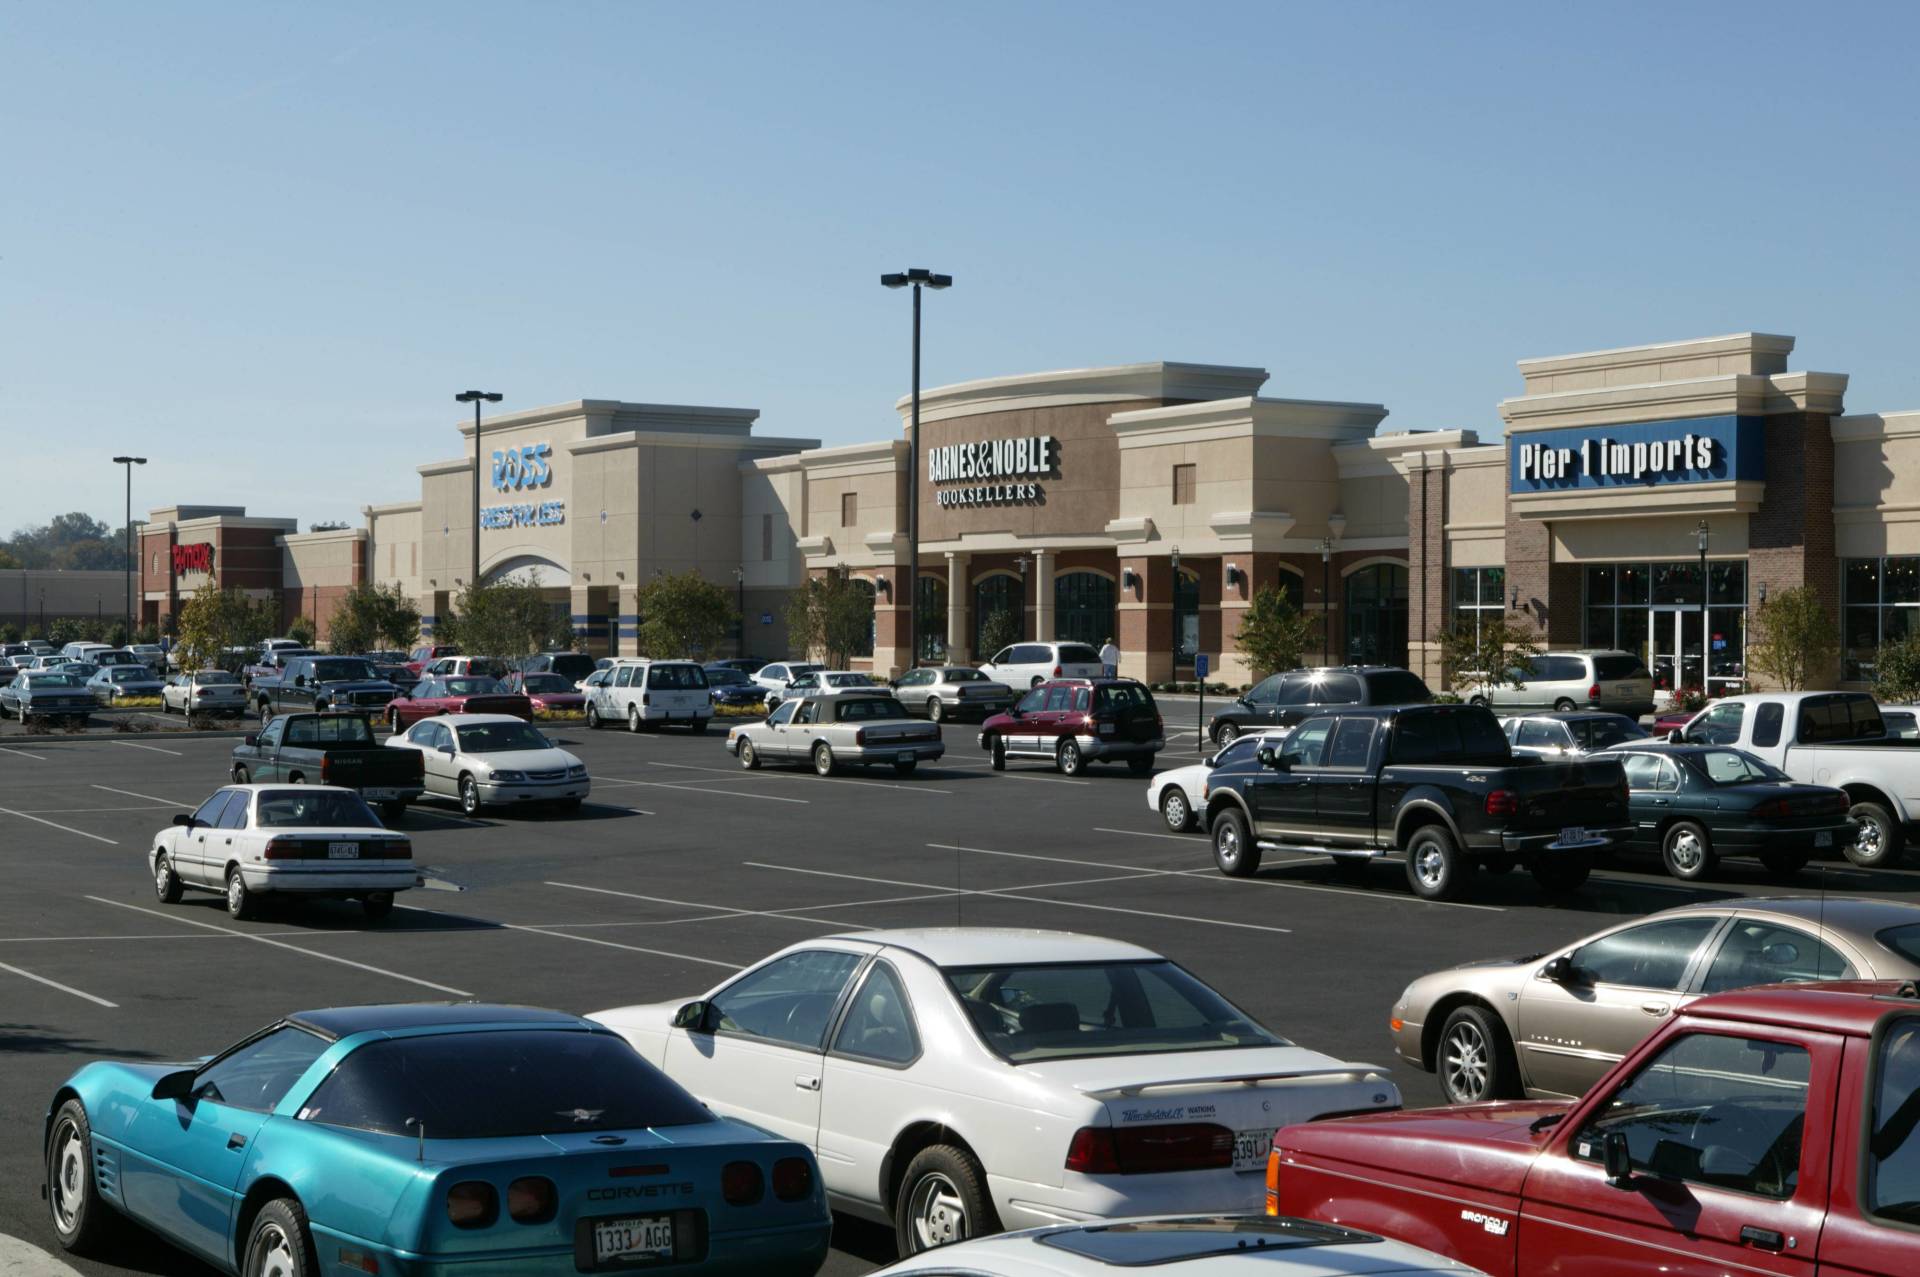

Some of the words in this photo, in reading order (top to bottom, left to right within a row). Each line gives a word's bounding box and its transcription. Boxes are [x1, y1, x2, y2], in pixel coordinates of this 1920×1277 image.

[492, 443, 548, 489] ROSS
[1520, 444, 1571, 480] Pier
[1581, 439, 1590, 477] 1
[1601, 434, 1712, 479] imports
[937, 483, 1036, 505] BOOKSELLERS
[1187, 1105, 1216, 1114] WATKINS
[587, 1182, 695, 1200] CORVETTE
[596, 1228, 632, 1253] 1333
[645, 1225, 671, 1249] AGG
